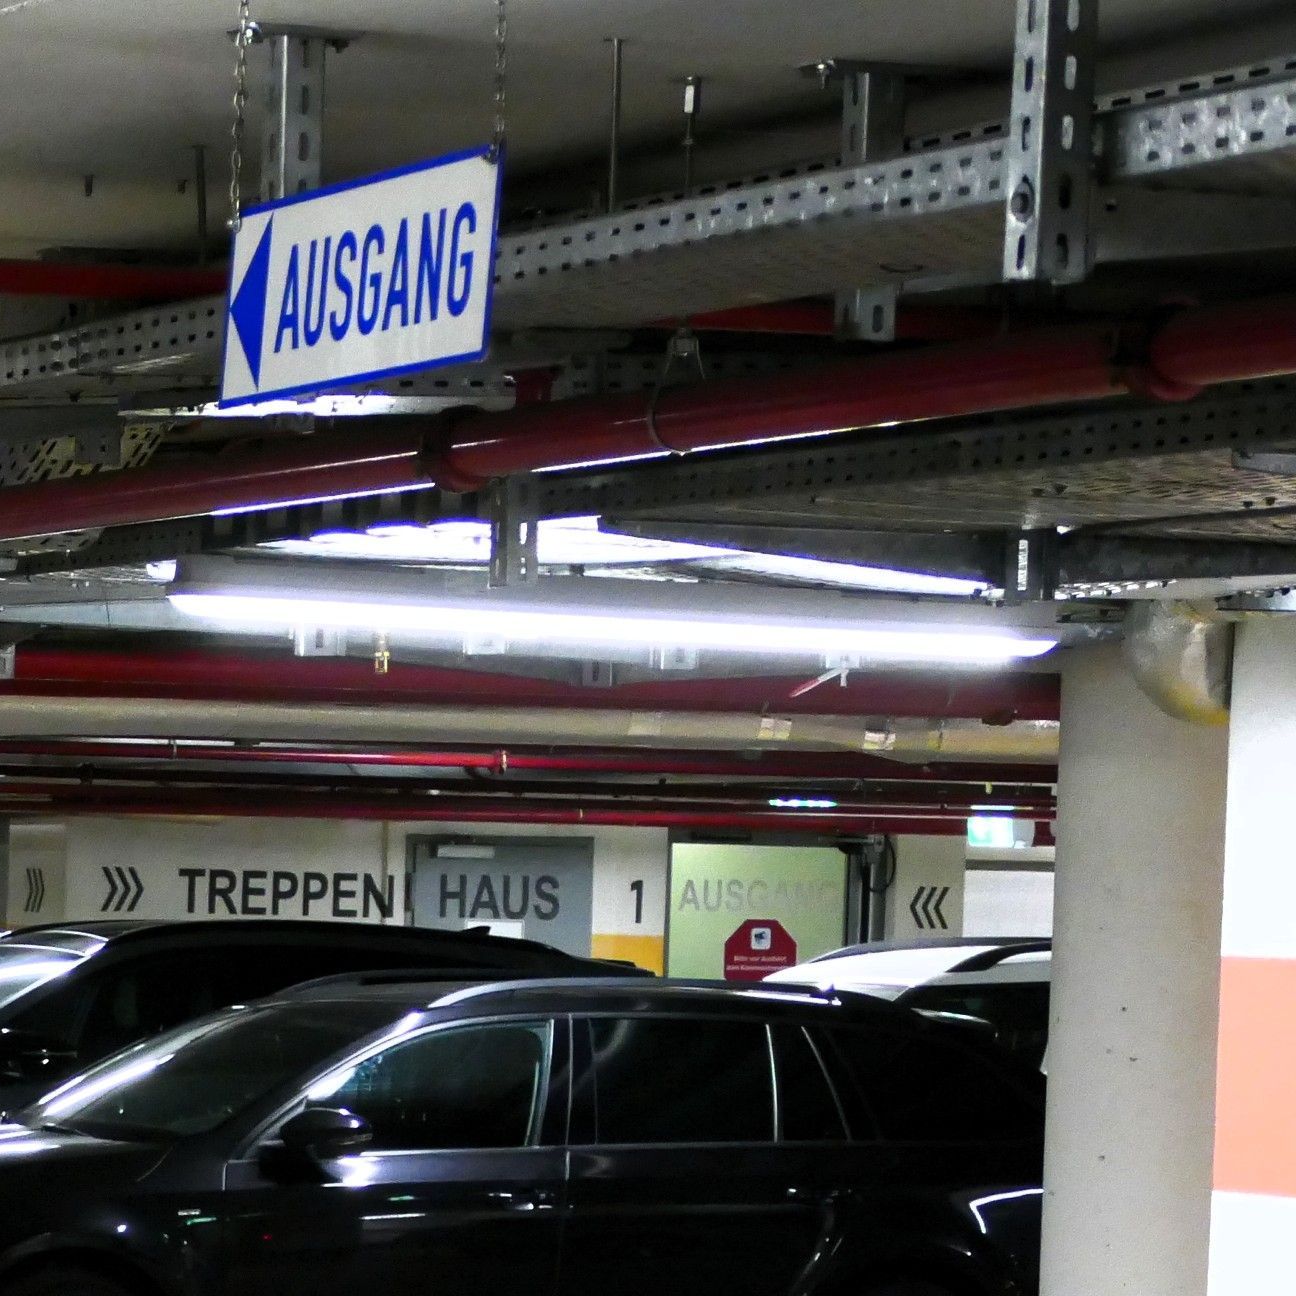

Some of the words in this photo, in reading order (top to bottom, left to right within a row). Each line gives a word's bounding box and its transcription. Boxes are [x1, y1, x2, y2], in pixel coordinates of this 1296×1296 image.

[274, 202, 477, 353] AUSGANG
[178, 868, 395, 919] TREPPEN
[439, 873, 560, 920] HAUS
[629, 879, 644, 924] 1
